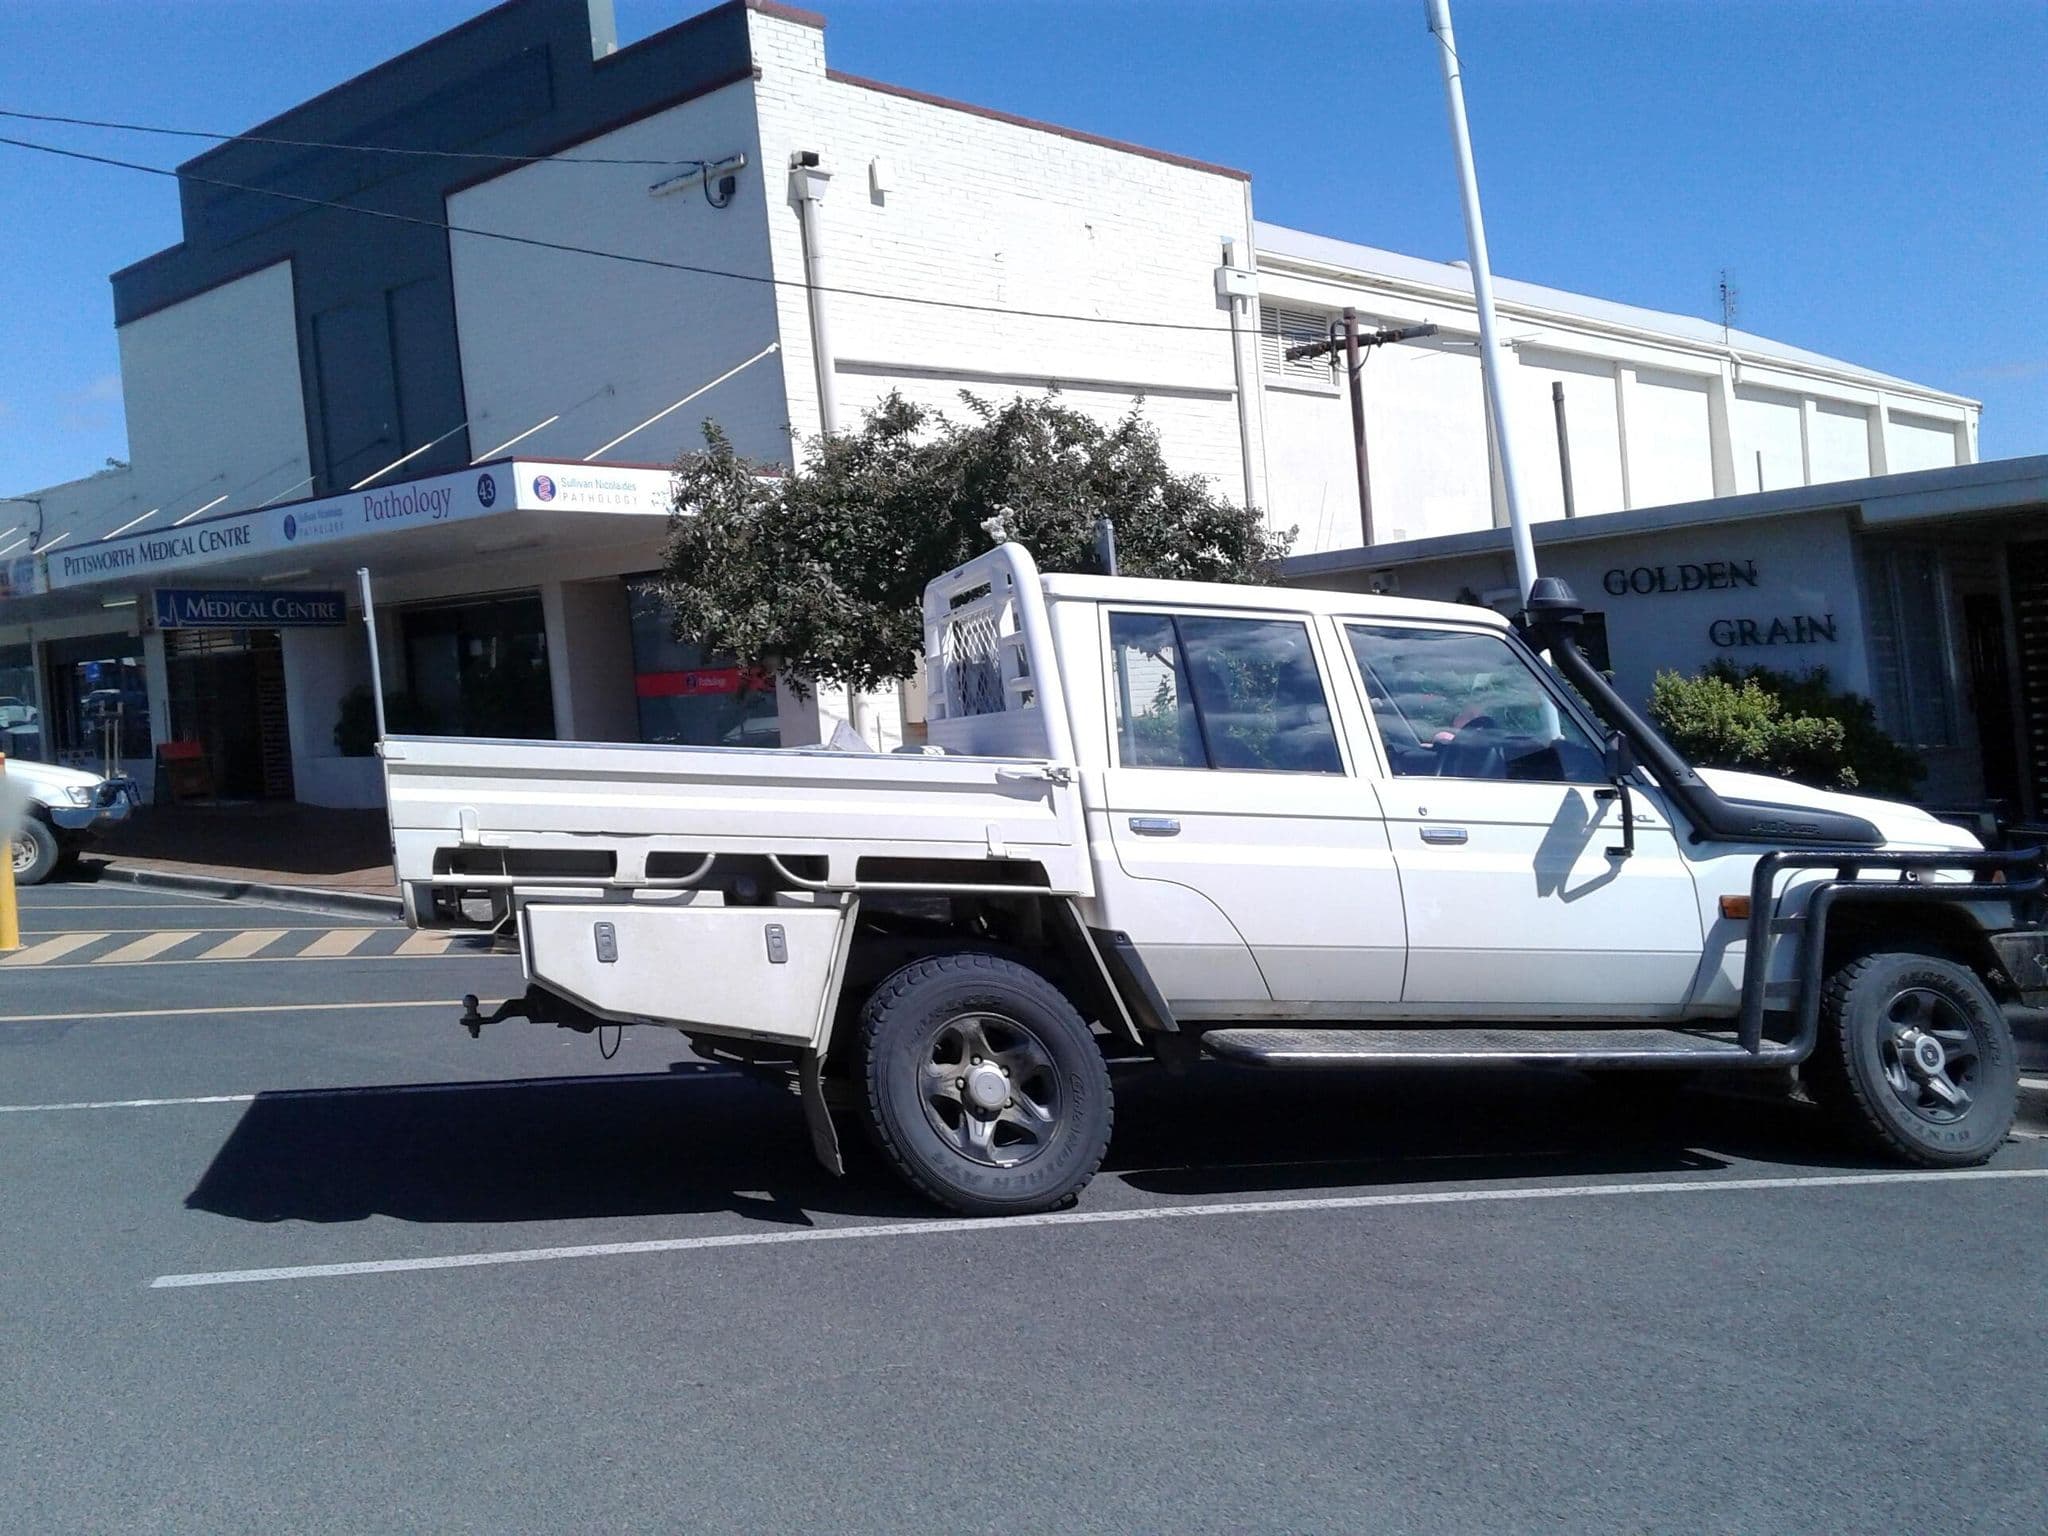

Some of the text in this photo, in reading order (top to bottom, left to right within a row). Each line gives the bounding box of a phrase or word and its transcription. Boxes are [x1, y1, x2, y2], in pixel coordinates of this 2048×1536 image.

[363, 486, 452, 522] Pathology
[479, 479, 495, 500] 43
[562, 492, 639, 505] PATHOLOGY
[63, 546, 135, 577] PITTSWORTH
[139, 536, 196, 563] MEDICAL
[199, 525, 251, 553] CENTRE
[1603, 559, 1760, 596] GOLDEN
[186, 597, 337, 619] MEDICAL CENTRE
[1709, 614, 1838, 648] GRAIN
